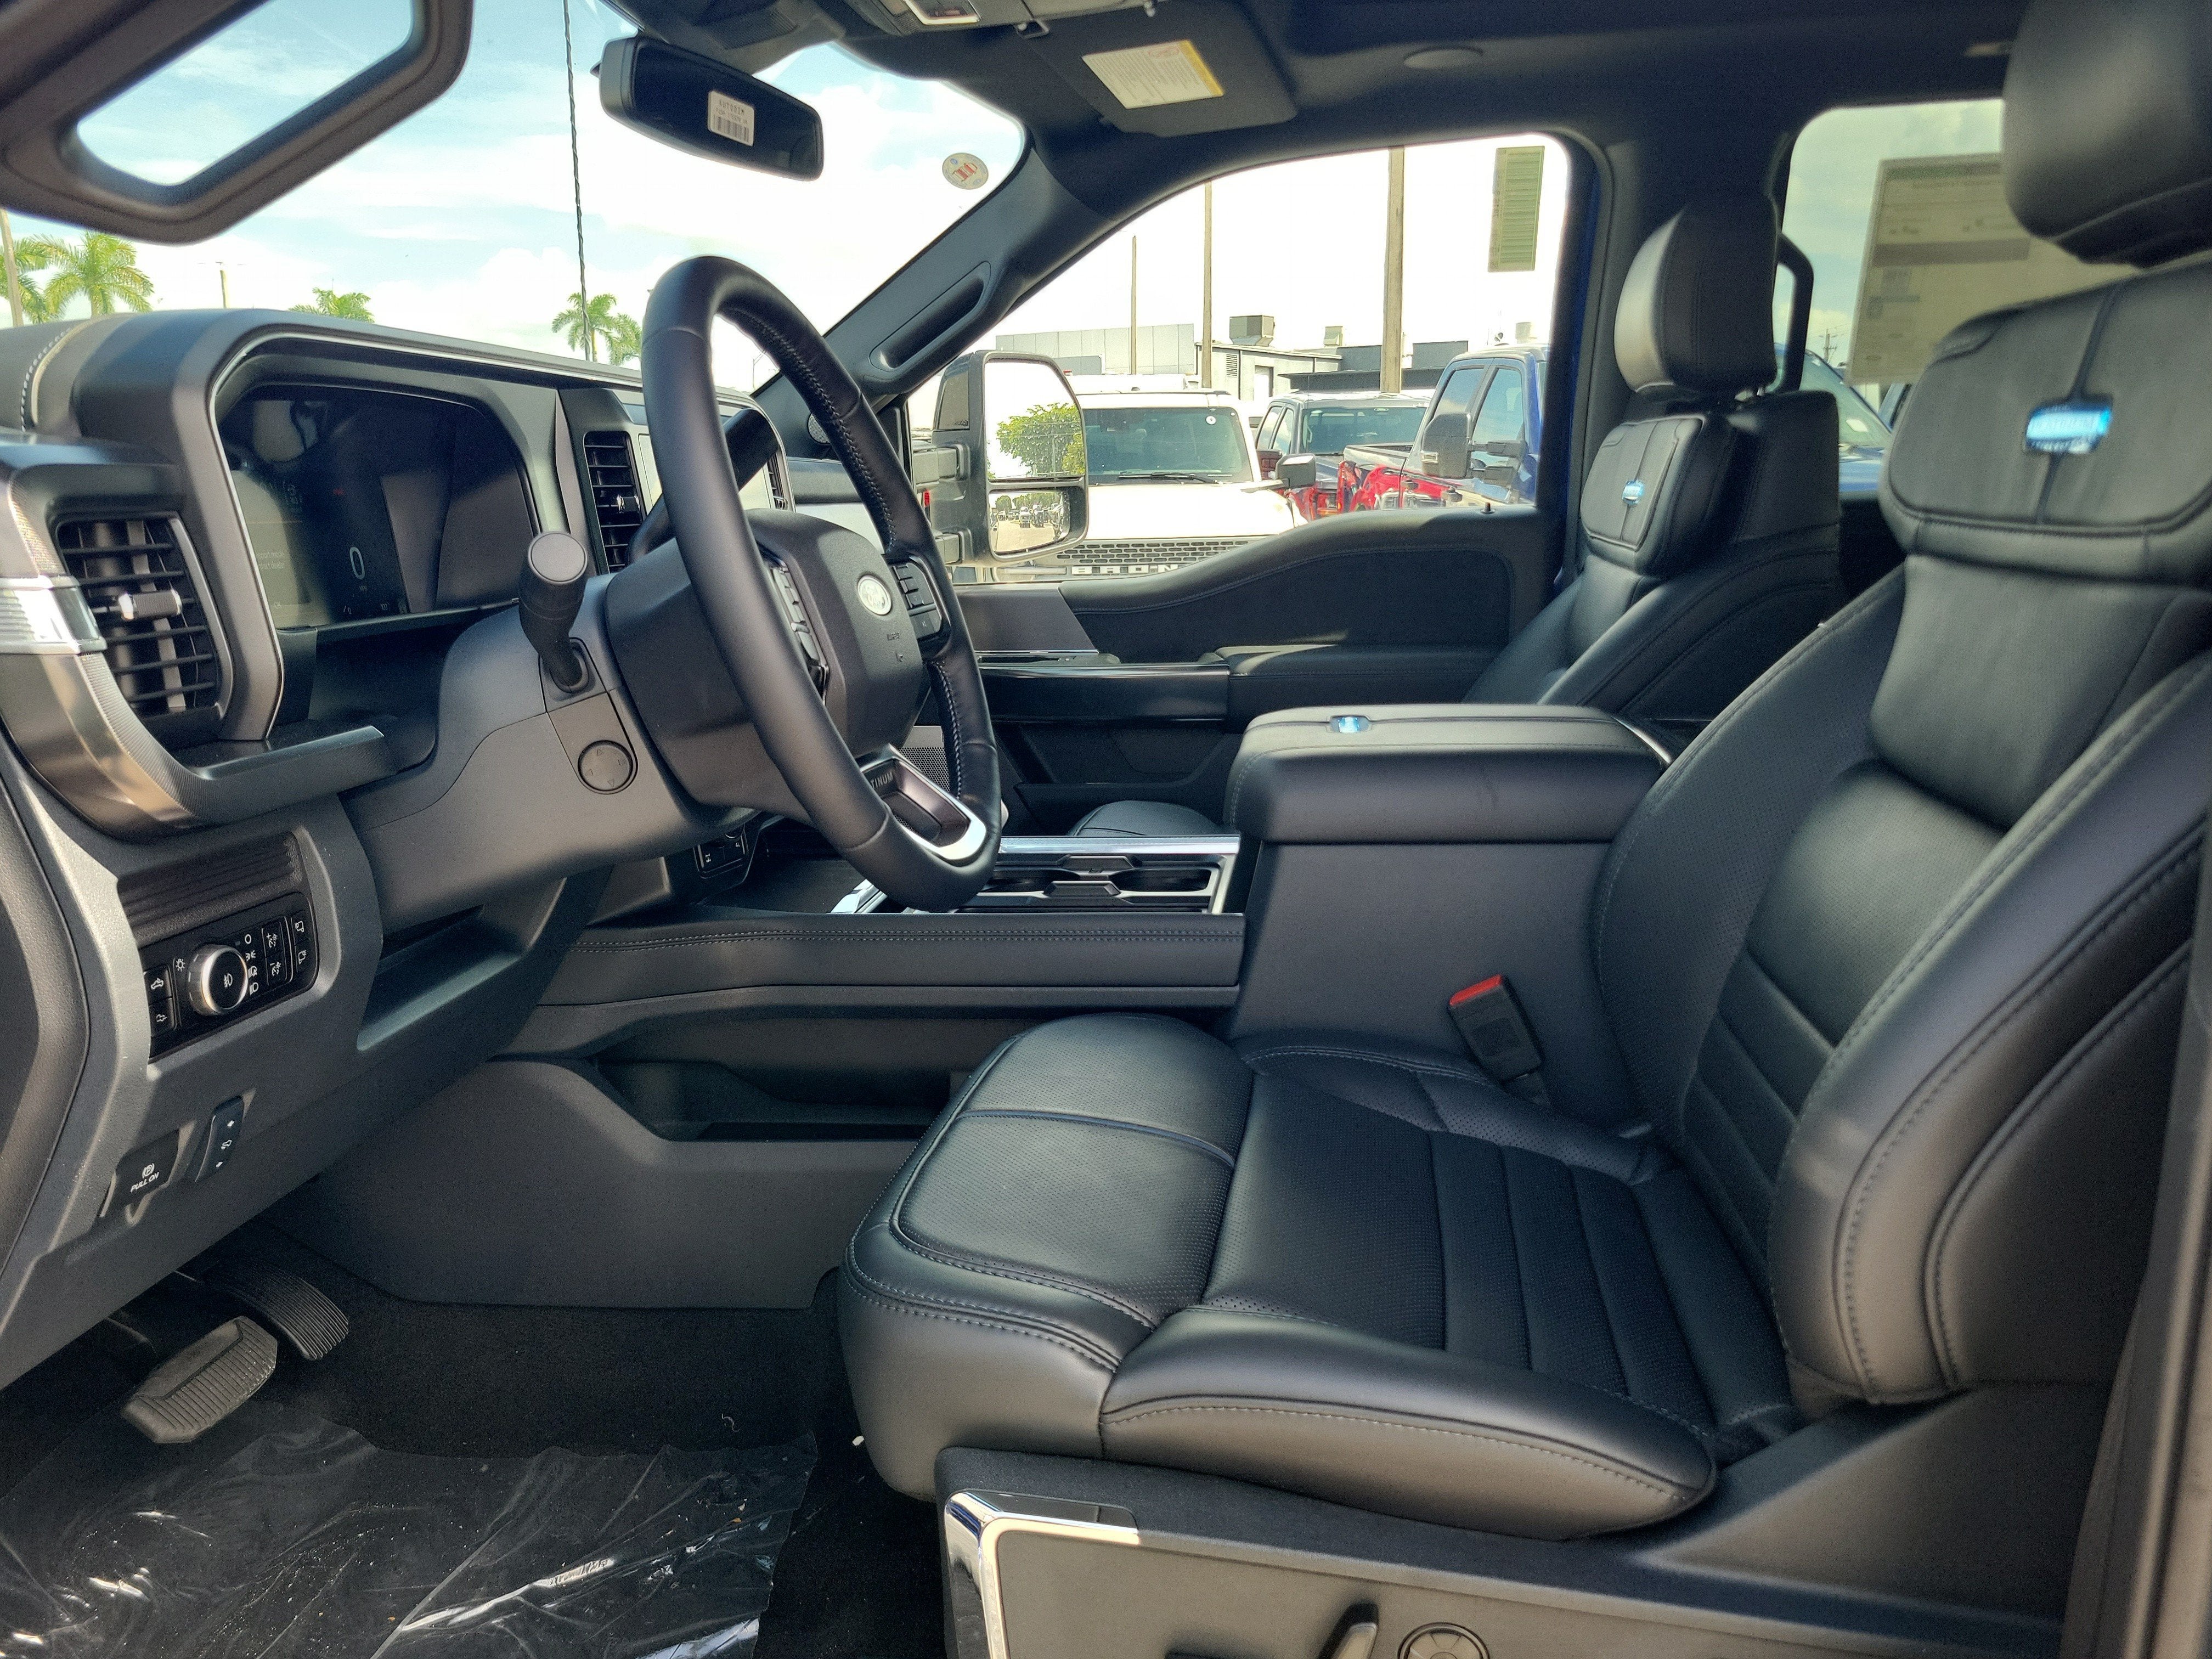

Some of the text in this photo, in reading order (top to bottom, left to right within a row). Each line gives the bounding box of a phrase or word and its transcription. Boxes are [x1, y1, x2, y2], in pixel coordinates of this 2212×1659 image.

[349, 547, 365, 580] 0
[130, 1171, 160, 1193] PULL ON
